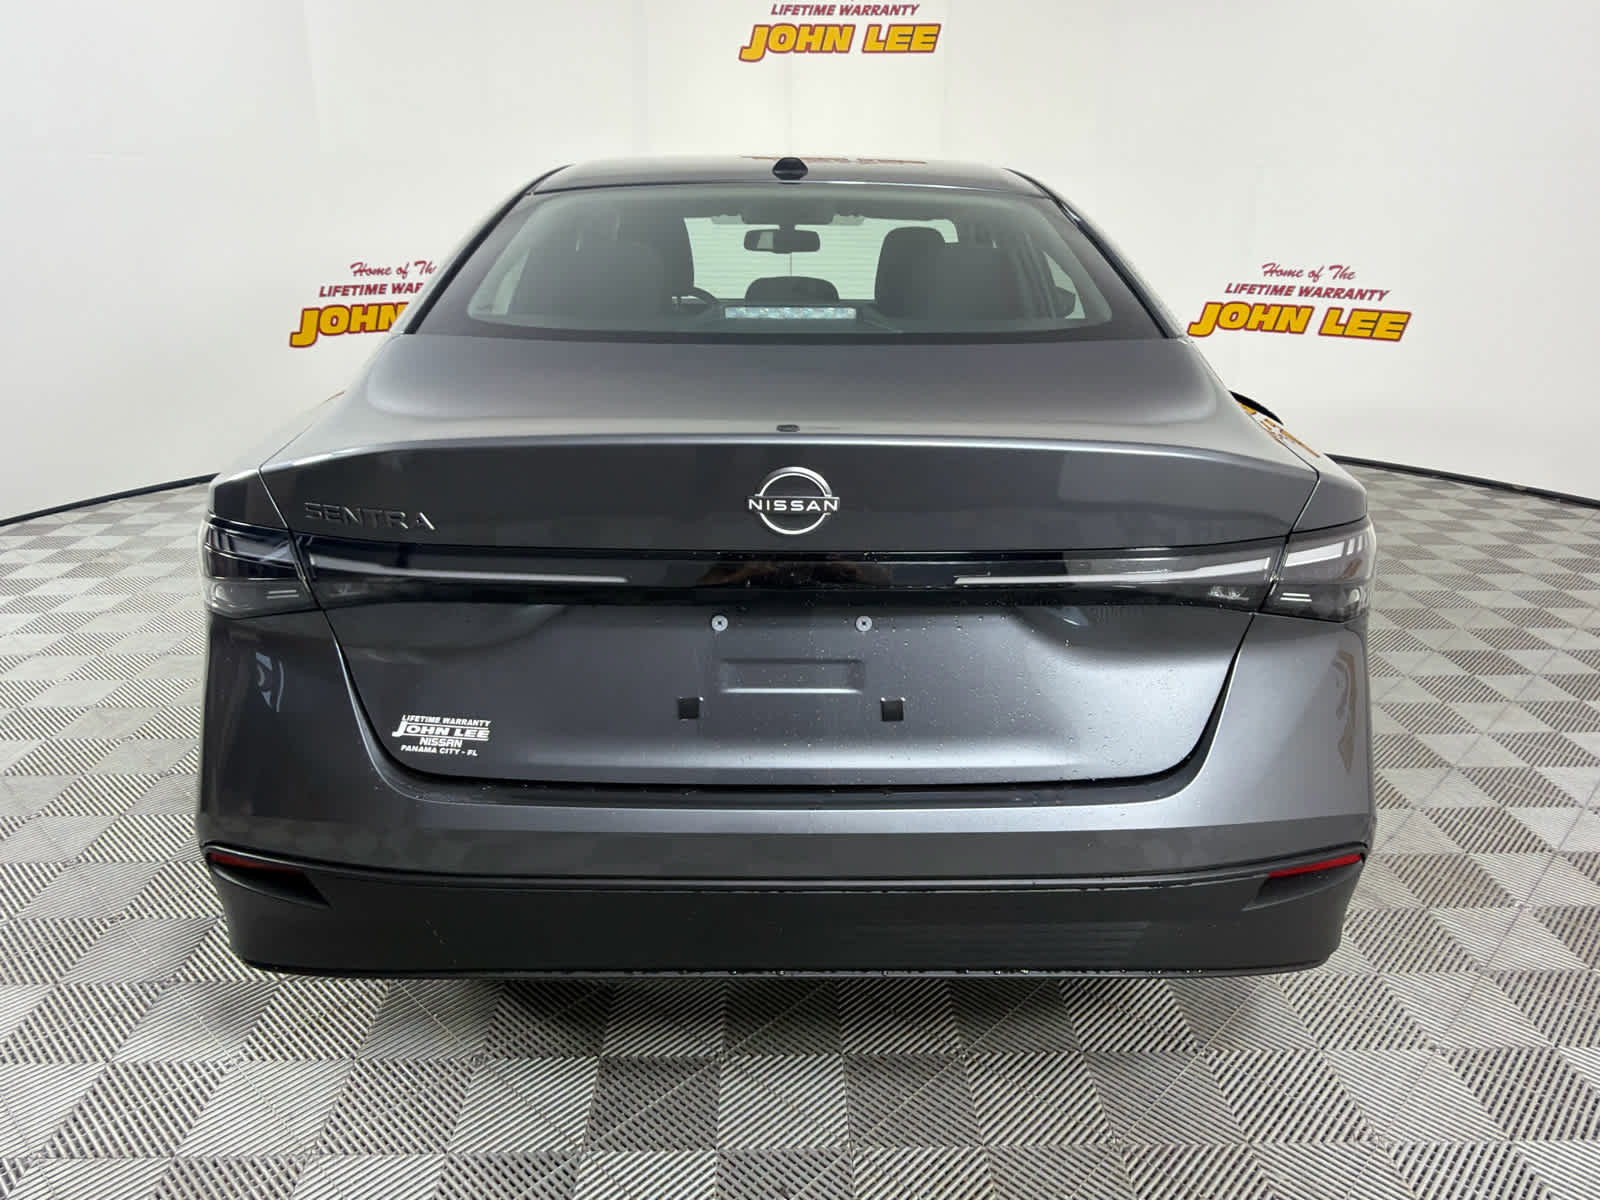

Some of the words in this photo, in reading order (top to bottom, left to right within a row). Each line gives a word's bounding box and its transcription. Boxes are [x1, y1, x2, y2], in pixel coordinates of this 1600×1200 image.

[771, 4, 836, 16] LIFETIME
[839, 4, 920, 16] WARRANTY
[738, 22, 856, 62] JOHN
[861, 23, 942, 53] LEE
[350, 261, 392, 276] Home
[396, 262, 410, 279] of
[413, 260, 437, 275] Th
[1262, 262, 1304, 278] Home
[1307, 265, 1325, 283] of
[1328, 264, 1356, 281] The
[319, 283, 388, 298] LIFETIME
[1225, 282, 1296, 297] LIFETIME
[1299, 285, 1390, 302] WARRANTY
[1187, 301, 1315, 337] JOHN
[1318, 306, 1412, 342] LEE
[748, 498, 838, 512] NISSAN
[304, 502, 436, 531] SENTRA
[402, 714, 441, 724] LIFETIME
[442, 717, 491, 727] WARRANTY
[454, 727, 490, 738] LEE
[419, 737, 463, 748] NISSAN
[400, 744, 437, 754] PANAMA
[467, 749, 478, 757] FL
